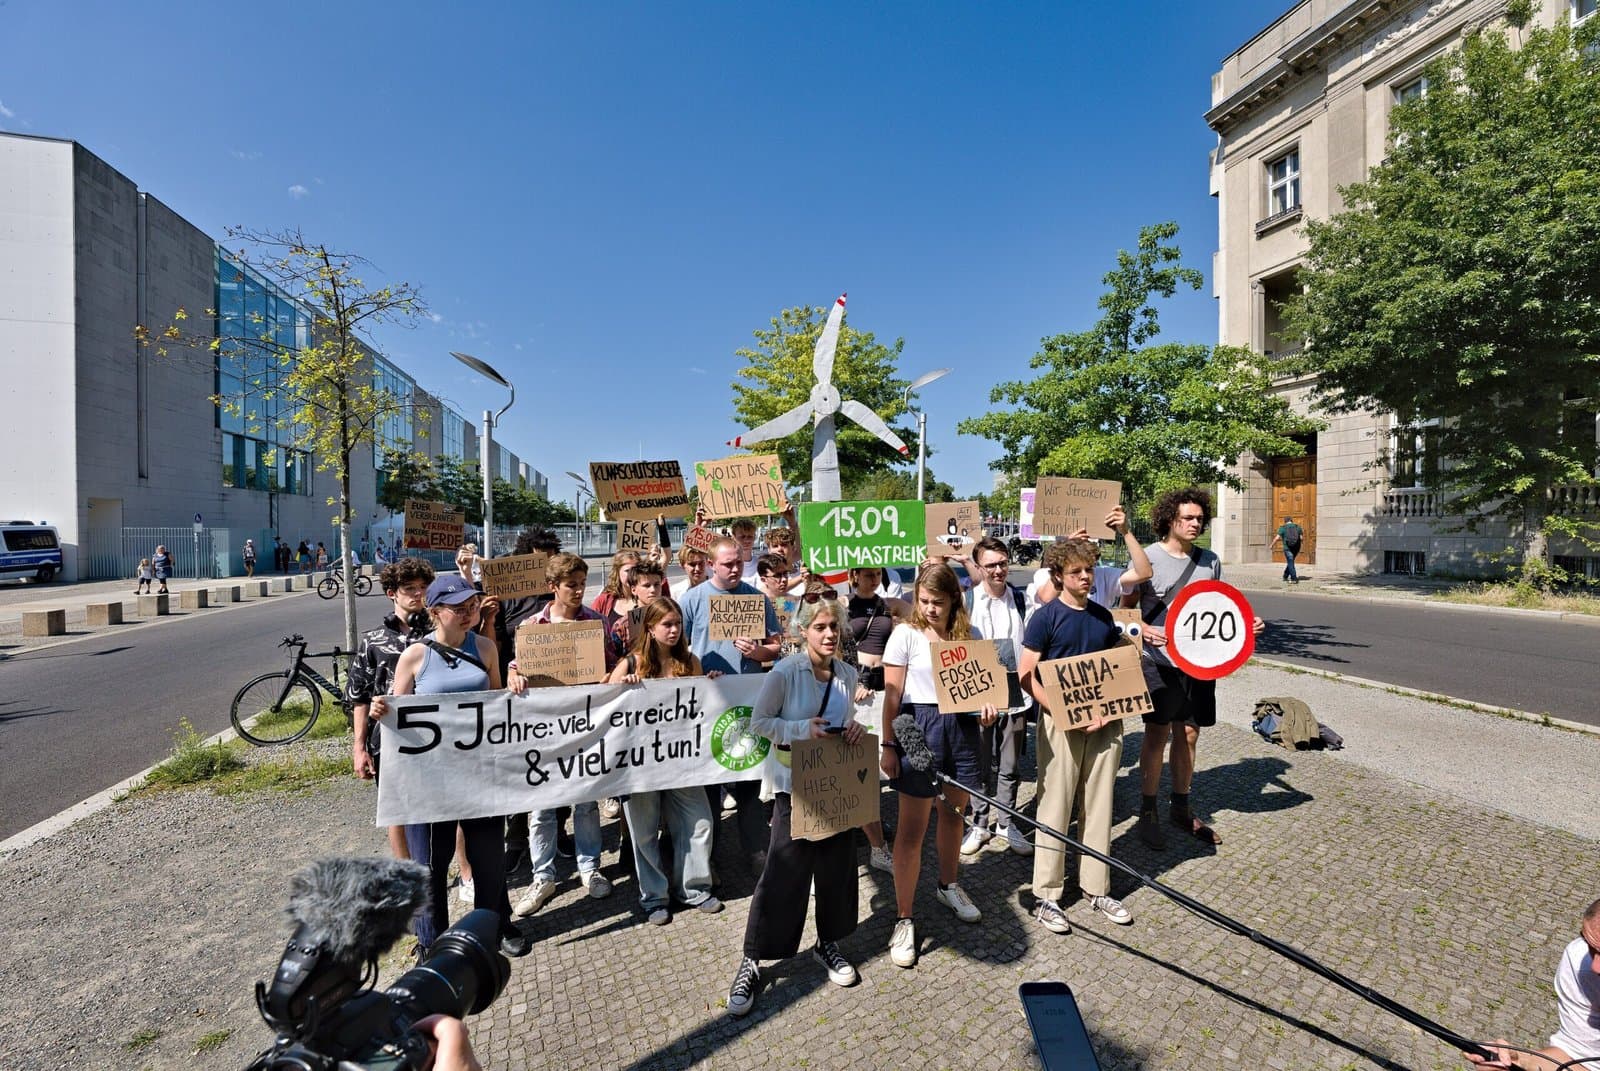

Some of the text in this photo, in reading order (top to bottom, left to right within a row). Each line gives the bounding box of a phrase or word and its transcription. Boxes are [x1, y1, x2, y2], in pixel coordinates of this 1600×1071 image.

[704, 463, 768, 481] WO IST DAS
[700, 482, 783, 515] KLIMAGELD?
[1044, 483, 1060, 497] Wir
[412, 502, 430, 510] EUER
[1043, 502, 1060, 516] bis
[410, 511, 456, 521] VERBRENNER
[819, 505, 906, 537] 15.09.
[421, 521, 464, 533] VERBRENNT
[624, 520, 649, 535] FCK
[690, 528, 718, 543] 15.0
[431, 533, 462, 547] ERDE
[622, 534, 649, 550] RWE
[809, 544, 927, 571] KLIMASTREIK
[482, 559, 544, 576] KLIMAZIELE
[485, 580, 537, 596] EINHALTEN
[711, 600, 764, 613] KLIMAZIELE
[711, 613, 764, 623] ABSCHAFFEN
[1183, 611, 1236, 641] 120
[722, 625, 752, 638] WTF!
[940, 646, 967, 667] END
[939, 659, 986, 687] FOSSIL
[1055, 657, 1119, 690] KLIMA-
[949, 672, 995, 704] FUELS!
[1063, 684, 1104, 706] KRISE
[1067, 691, 1152, 725] IST JETZT!
[397, 687, 704, 754] 5 Jahre: viel erreicht,
[525, 723, 701, 786] & viel zu tun!
[801, 743, 865, 771] WIR SIND
[803, 775, 841, 796] HIER,
[803, 794, 860, 818] WIR SIND
[803, 814, 849, 832] LAUT!!!
